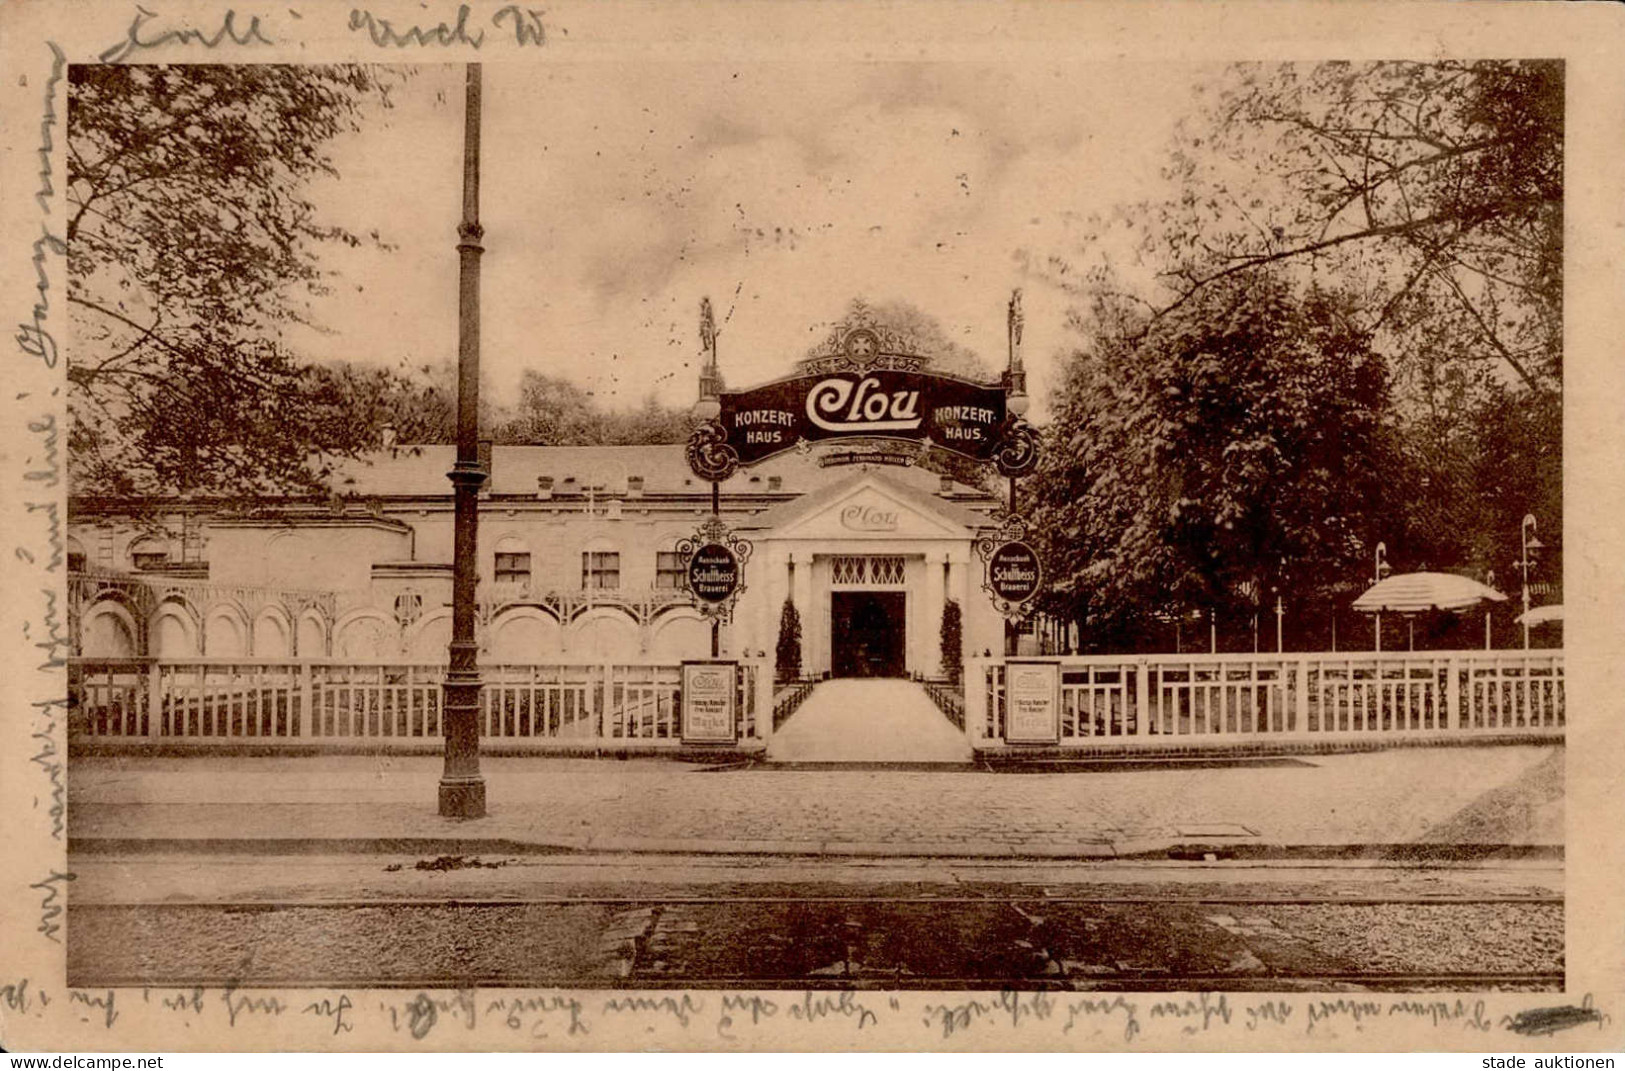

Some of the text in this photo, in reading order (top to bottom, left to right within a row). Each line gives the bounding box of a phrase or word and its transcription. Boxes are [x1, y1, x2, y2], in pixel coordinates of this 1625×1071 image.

[806, 377, 922, 431] Clou
[746, 430, 782, 444] HAUS
[841, 505, 898, 532] Clou
[699, 583, 728, 592] Brauerei
[1000, 582, 1030, 591] Brauerei
